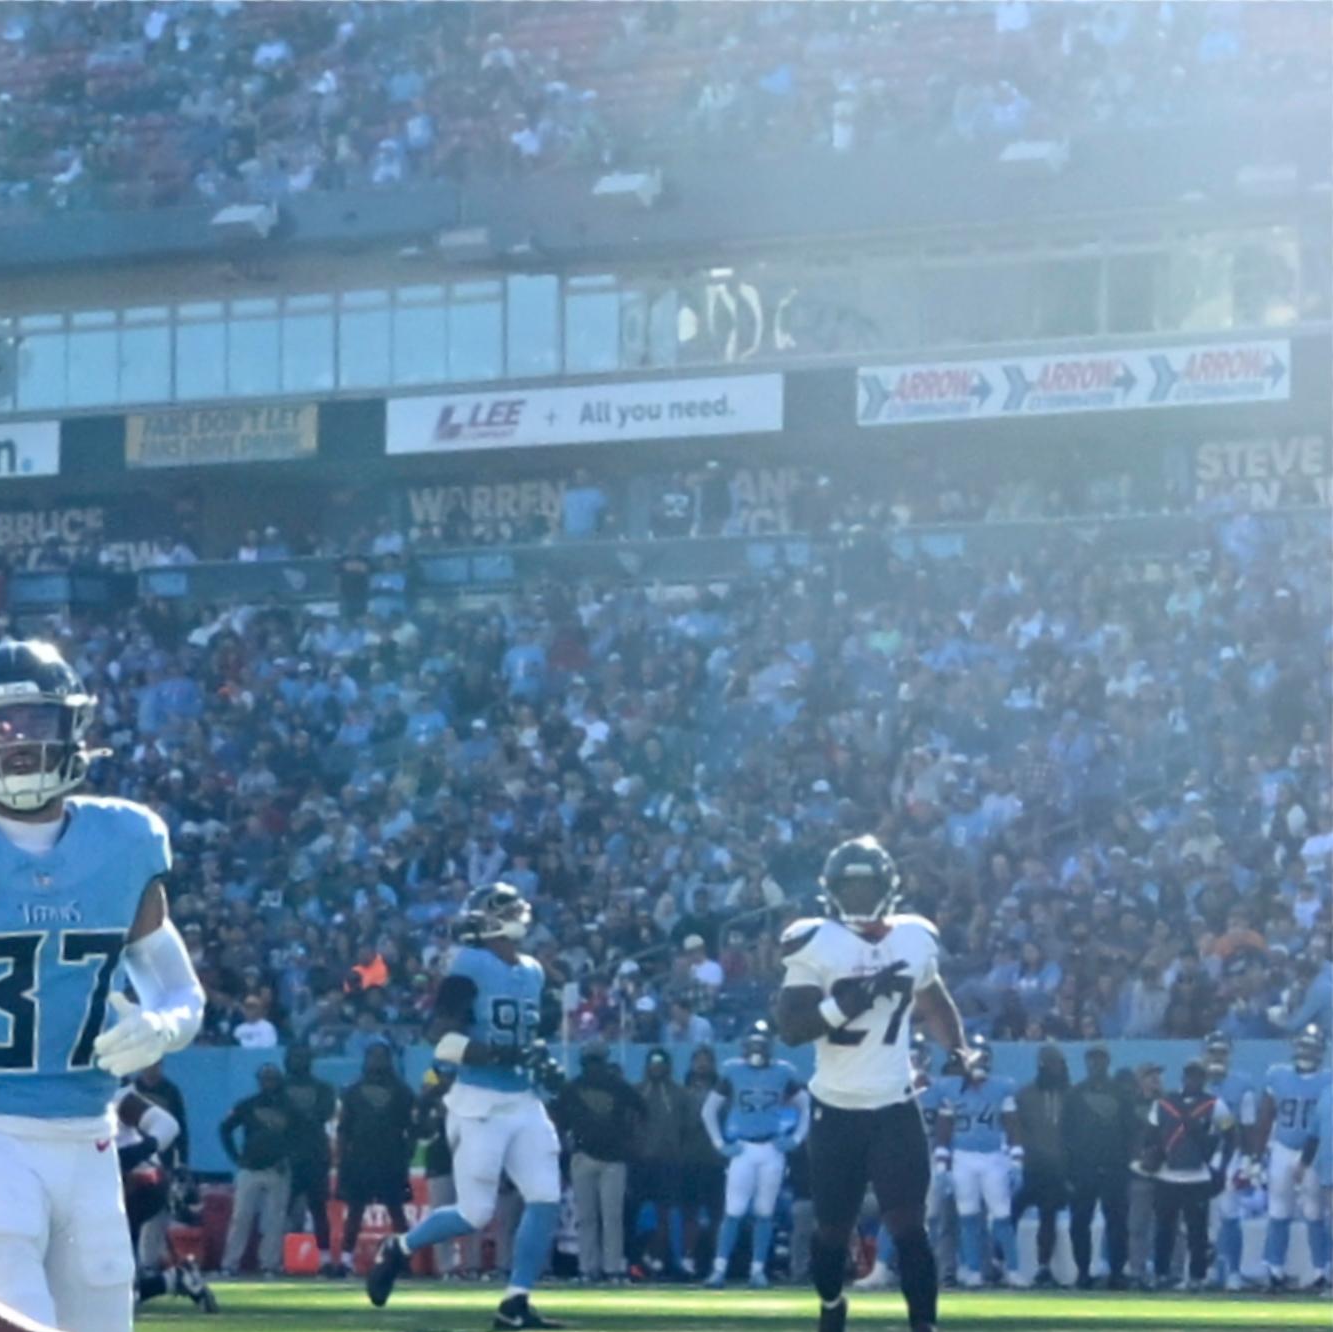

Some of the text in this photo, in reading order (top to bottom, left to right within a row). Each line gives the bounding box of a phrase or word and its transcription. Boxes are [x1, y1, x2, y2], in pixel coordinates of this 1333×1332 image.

[467, 399, 527, 428] LEE
[579, 401, 611, 425] All
[616, 402, 662, 429] you
[668, 392, 737, 420] need.
[1196, 436, 1324, 480] STEVE
